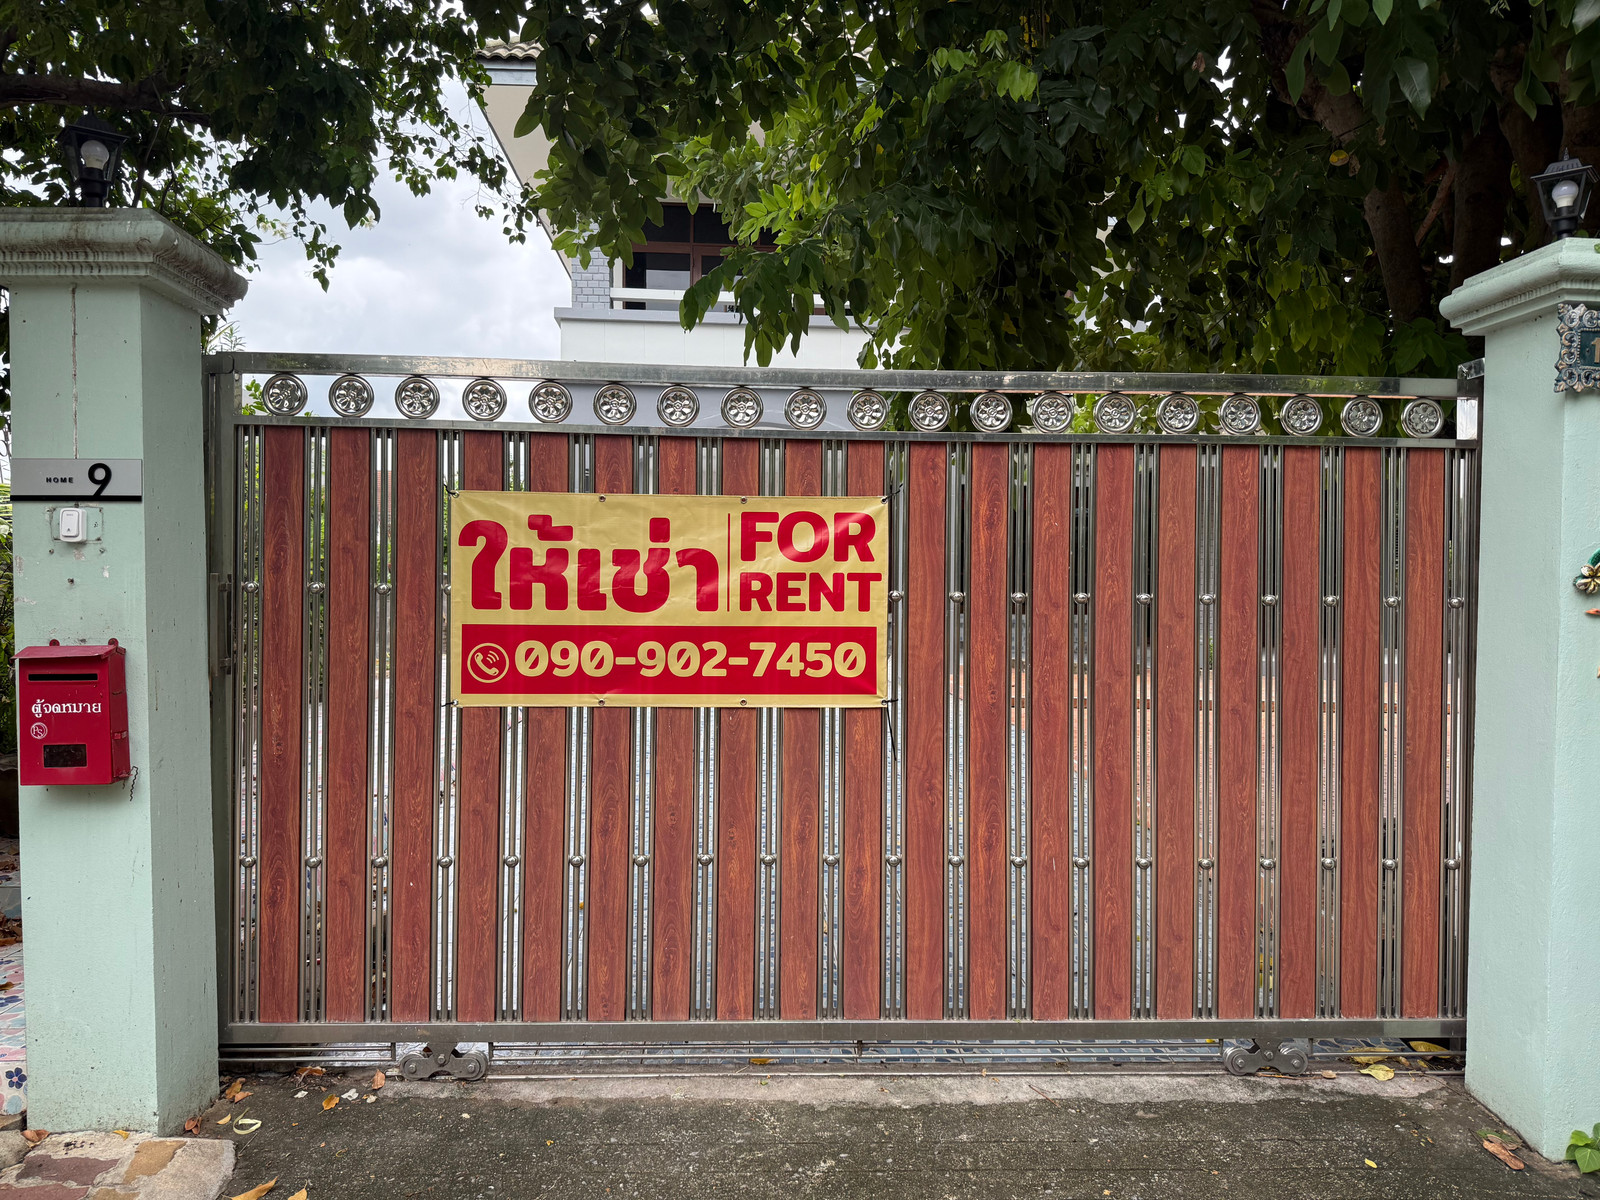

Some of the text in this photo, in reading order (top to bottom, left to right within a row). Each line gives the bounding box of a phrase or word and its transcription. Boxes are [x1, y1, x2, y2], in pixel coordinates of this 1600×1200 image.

[45, 463, 112, 497] HOME 9
[740, 510, 876, 563] FOR
[458, 514, 720, 614] ให้เช่า
[739, 572, 883, 613] RENT
[515, 640, 867, 678] 090-902-7450
[31, 698, 102, 719] ตู้จดหมาย
